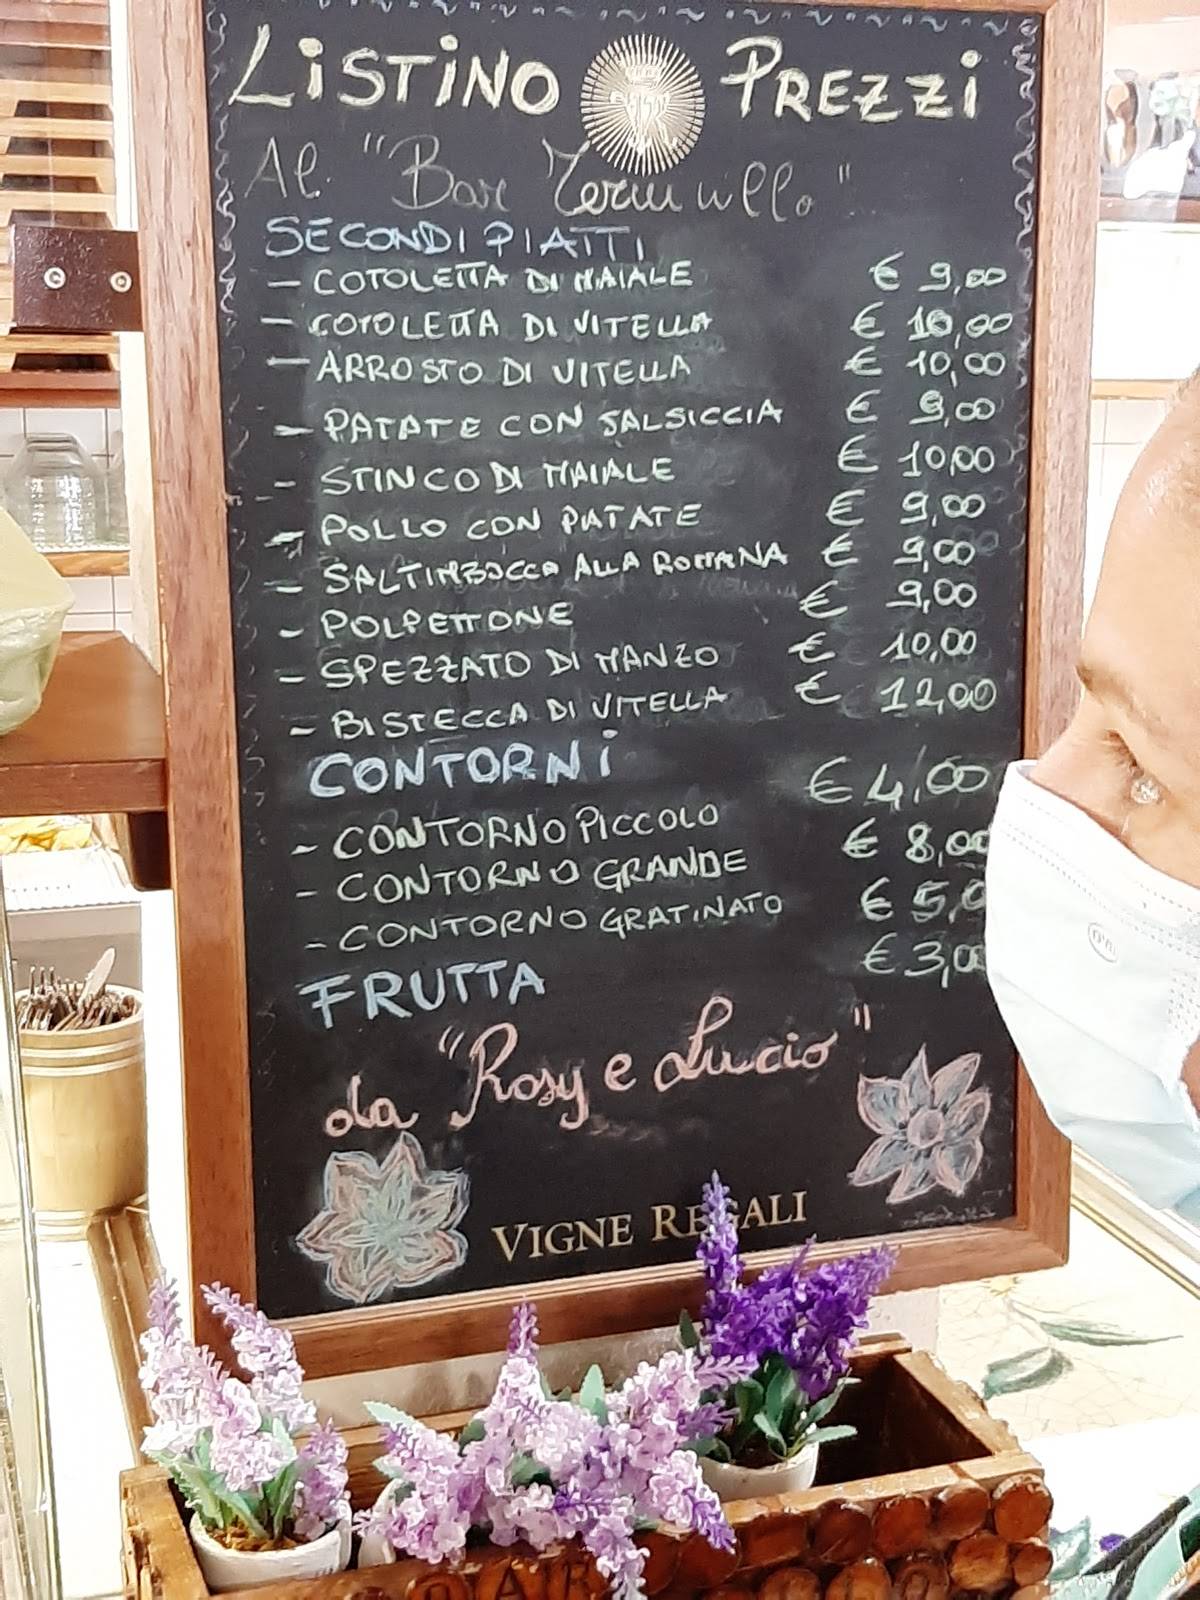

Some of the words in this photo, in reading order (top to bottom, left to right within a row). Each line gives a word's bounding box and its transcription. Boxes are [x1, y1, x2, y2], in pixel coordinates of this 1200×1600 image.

[265, 216, 466, 257] SECONDI
[484, 220, 644, 261] PIATTI
[313, 261, 508, 295] COTOLETTA
[525, 268, 559, 294] DI
[574, 260, 693, 293] MAIALE
[869, 251, 904, 290] €
[918, 262, 1007, 295] 9,00
[308, 308, 499, 339] COTOLETTA
[522, 313, 557, 342] DI
[574, 310, 713, 339] VITELLA
[851, 301, 885, 339] €
[907, 306, 1013, 349] 10,00
[317, 350, 483, 384] ARROSTO
[503, 357, 532, 387] DI
[553, 354, 691, 388] VITELLA
[843, 346, 882, 375] €
[905, 350, 1006, 387] 10,00
[324, 408, 481, 444] PATATE
[500, 402, 583, 437] CON
[598, 399, 783, 437] SALSICCIA
[846, 389, 881, 423] €
[909, 390, 995, 428] 9,00
[321, 465, 480, 495] STINCO
[489, 461, 523, 494] DI
[543, 458, 675, 489] MAIALE
[838, 434, 879, 472] €
[898, 440, 995, 476] 10,00
[321, 514, 447, 546] POLLO
[467, 507, 541, 540] CON
[561, 504, 702, 534] PATATE
[825, 489, 866, 526] €
[900, 490, 986, 527] 9,00
[323, 560, 559, 595] SALTIMBOCCA
[574, 551, 641, 582] ALLA
[653, 541, 788, 576] ROMANA
[821, 533, 859, 567] €
[893, 536, 975, 573] 9,00
[799, 580, 848, 619] €
[886, 578, 977, 614] 9,00
[321, 602, 573, 640] POLPETTONE
[320, 651, 531, 688] SPEZZATO
[545, 648, 580, 676] DI
[594, 643, 719, 674] MANZO
[788, 632, 836, 663] €
[880, 627, 977, 663] 10,00
[331, 702, 528, 740] BISTECCA
[546, 699, 577, 722] DI
[592, 686, 728, 720] VITELLA
[794, 670, 842, 704] €
[880, 677, 997, 715] 12,00
[804, 756, 853, 804] €
[866, 755, 990, 811] 4,00
[333, 814, 566, 859] CONTORNO
[575, 804, 719, 844] PICCOLO
[841, 817, 878, 858] €
[336, 859, 580, 904] CONTORNO
[593, 846, 748, 894] GRANDE
[339, 905, 588, 951] CONTORNO
[600, 892, 782, 940] GRATINATO
[861, 877, 893, 921] €
[912, 879, 986, 924] 5,0
[861, 932, 897, 974] €
[298, 960, 545, 1029] FRUTTA
[325, 1075, 419, 1137] da
[604, 1053, 637, 1091] e
[491, 1214, 634, 1262] VIGNE
